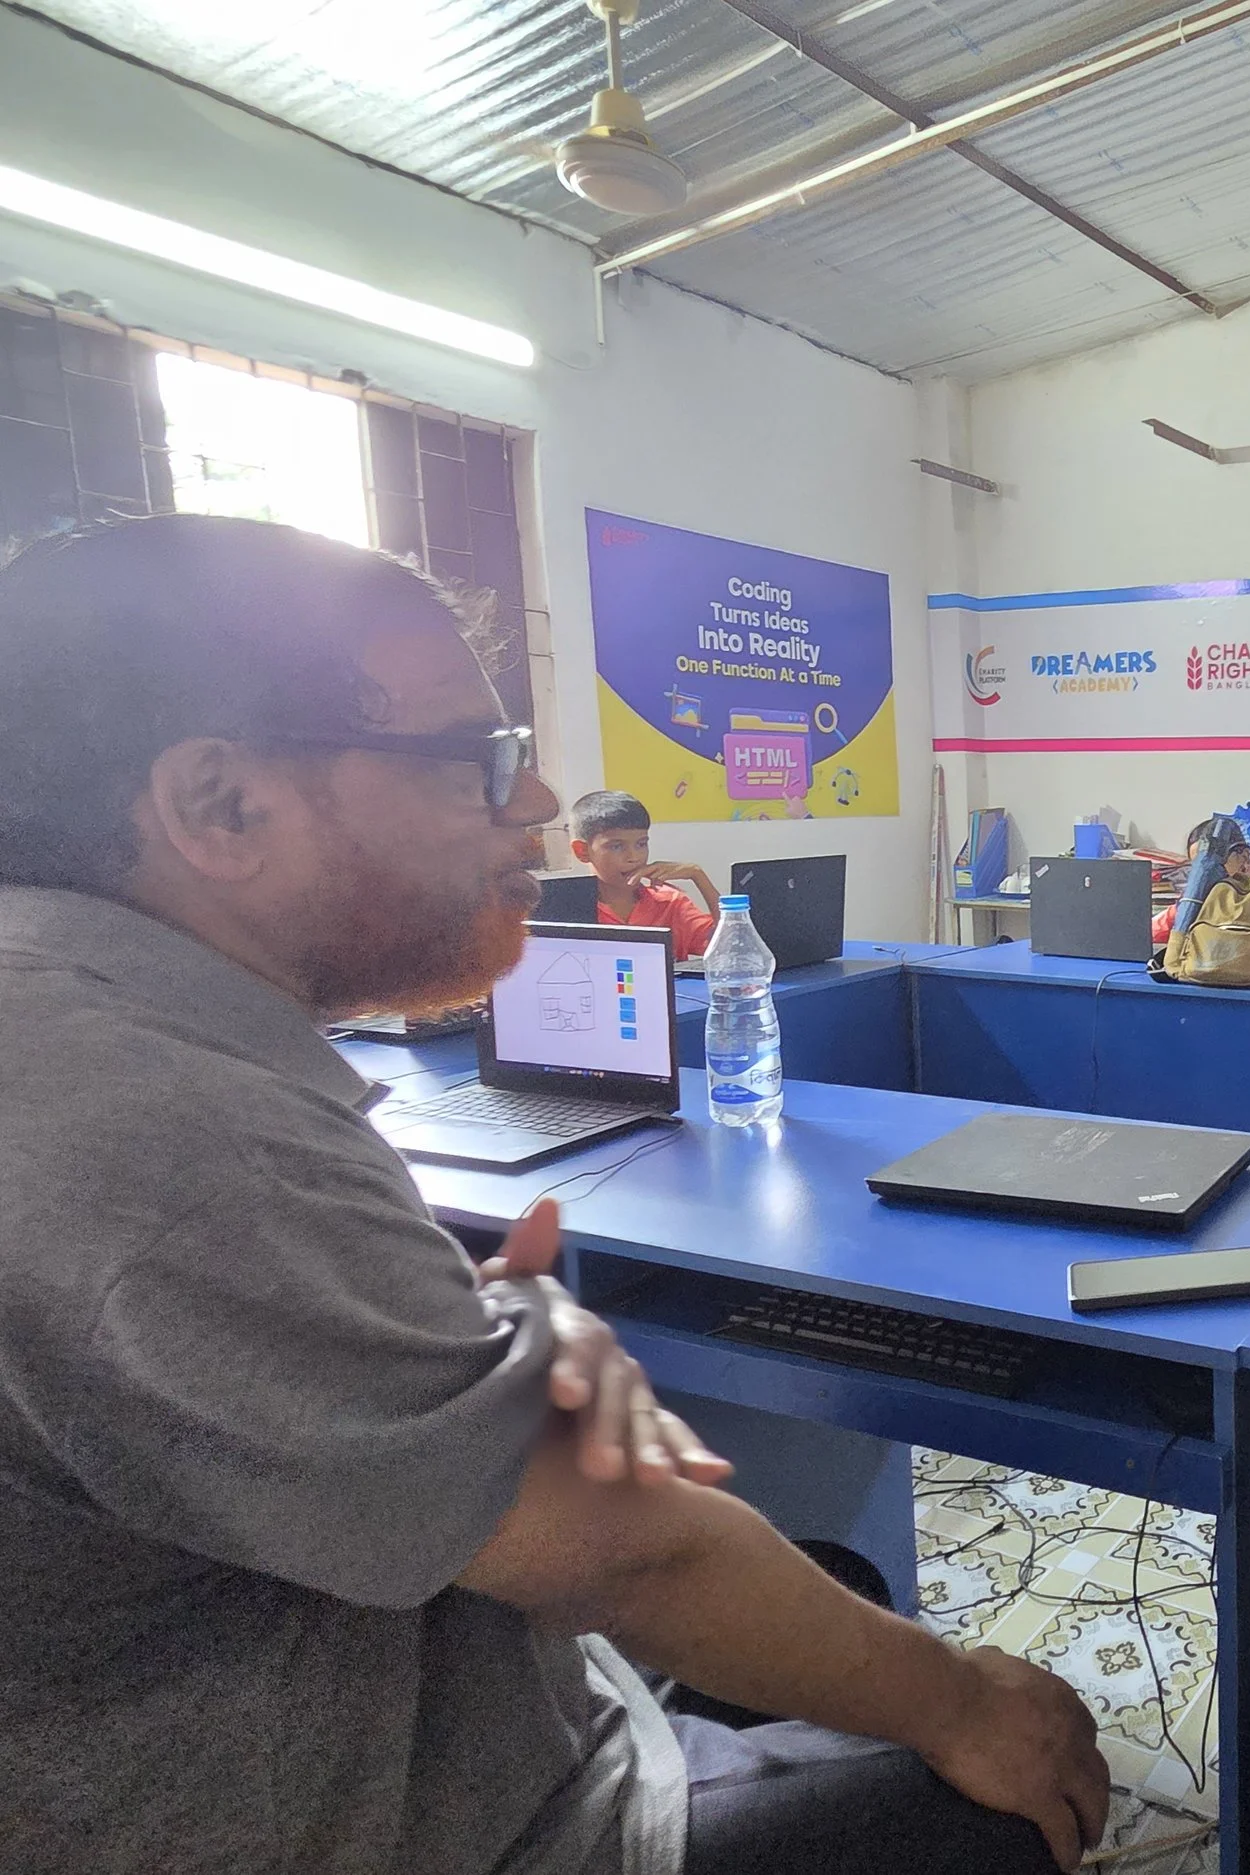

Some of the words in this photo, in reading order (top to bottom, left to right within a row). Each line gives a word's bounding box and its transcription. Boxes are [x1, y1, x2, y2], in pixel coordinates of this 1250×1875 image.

[728, 576, 792, 611] Coding
[710, 601, 761, 627] Turns
[764, 608, 809, 634] Ideas
[698, 625, 744, 654] Into
[749, 633, 821, 668] Reality
[676, 655, 709, 675] One
[712, 658, 777, 682] Function
[780, 662, 796, 682] At
[798, 669, 809, 684] a
[812, 670, 842, 687] Time
[1031, 650, 1158, 677] DREAMERS
[735, 746, 798, 769] HTML
